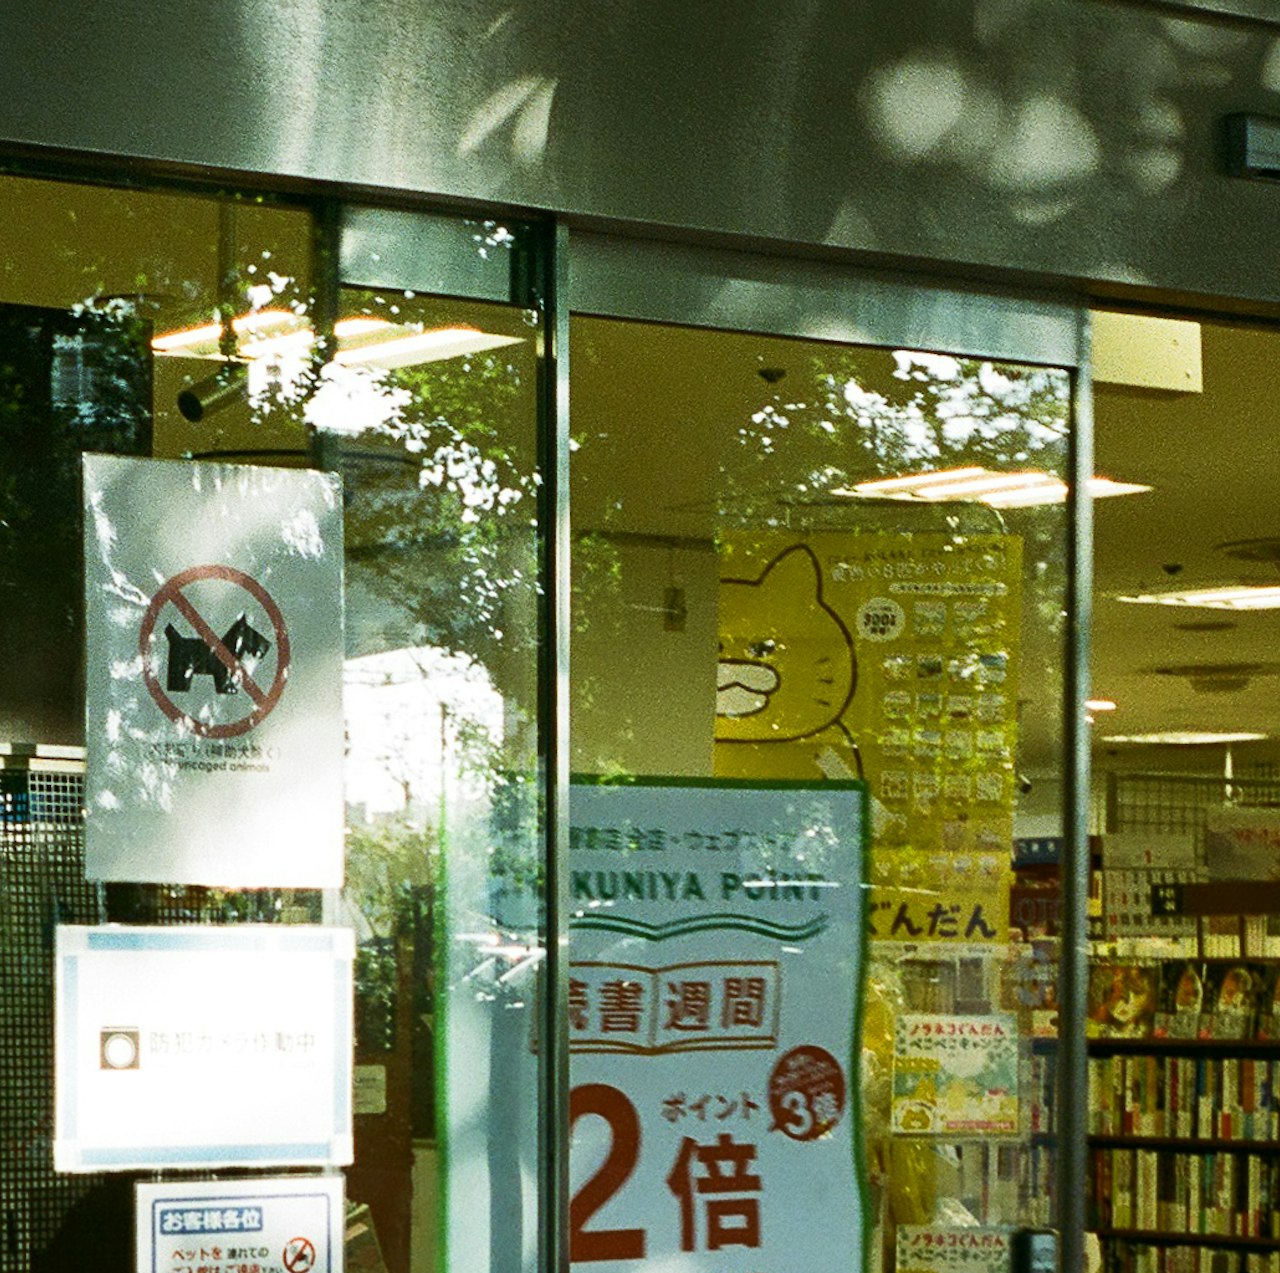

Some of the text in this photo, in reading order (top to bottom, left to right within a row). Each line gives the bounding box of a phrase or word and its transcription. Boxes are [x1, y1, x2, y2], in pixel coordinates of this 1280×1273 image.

[660, 1091, 761, 1124] ポイント
[665, 1132, 764, 1253] 倍
[163, 1210, 260, 1231] お客様各位
[171, 1246, 222, 1263] ペットを
